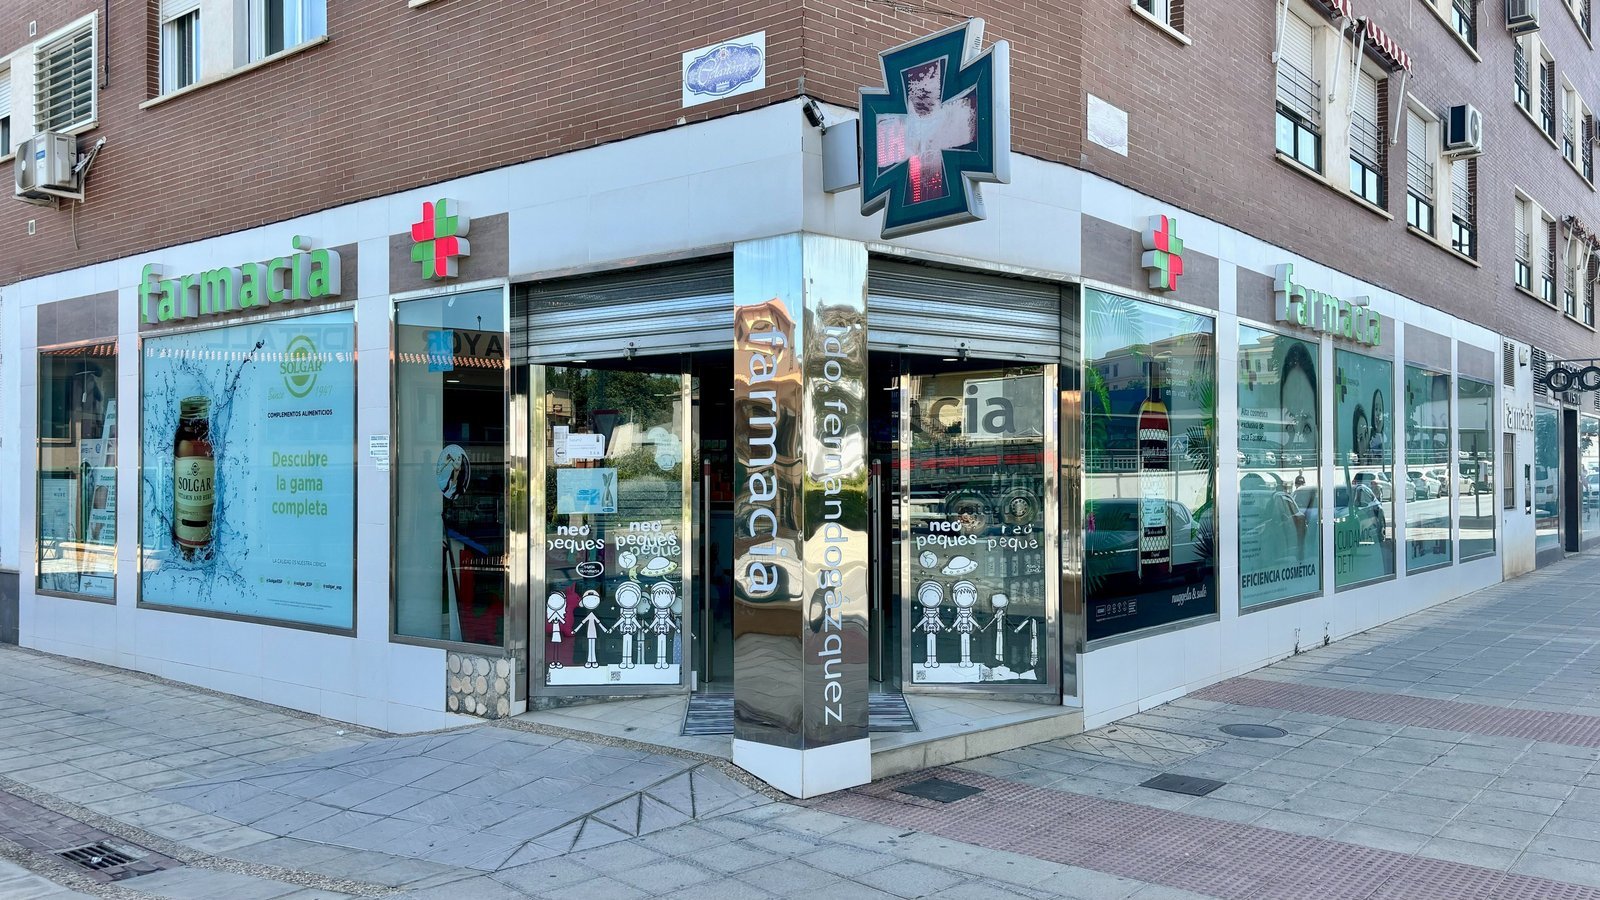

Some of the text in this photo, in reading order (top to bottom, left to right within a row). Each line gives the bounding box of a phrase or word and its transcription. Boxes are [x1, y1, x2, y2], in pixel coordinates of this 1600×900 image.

[138, 235, 341, 324] farmacia
[1276, 263, 1381, 346] farmacia
[280, 360, 322, 375] SOLGAR
[267, 408, 333, 419] COMPLEMENTOS ALIMENTICIOS
[272, 451, 328, 467] Descubre
[748, 326, 788, 593] farmacia
[178, 476, 211, 492] SOLGAR
[276, 475, 323, 494] la gama
[272, 498, 328, 518] completa
[557, 525, 590, 536] neo
[629, 520, 663, 532] neo
[929, 520, 962, 532] neo
[915, 534, 978, 550] peques
[1241, 563, 1316, 589] EFICIENCIA COSMÉTICA
